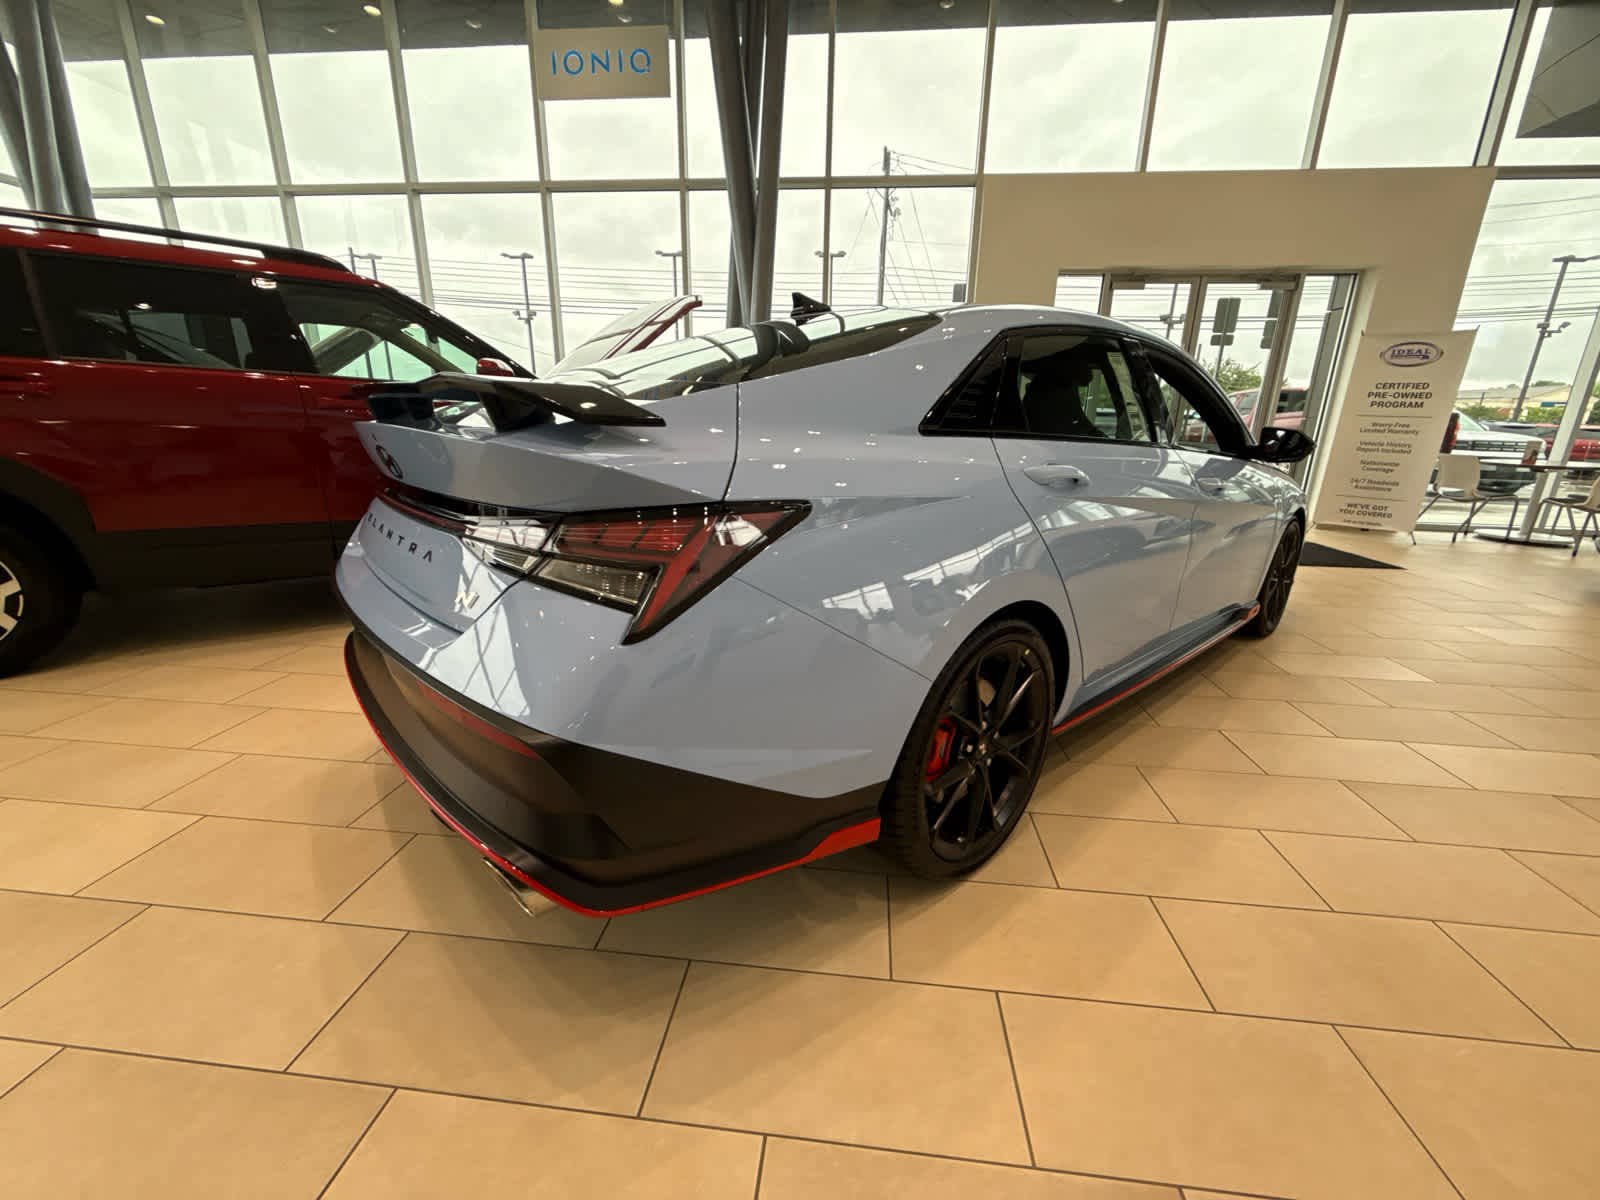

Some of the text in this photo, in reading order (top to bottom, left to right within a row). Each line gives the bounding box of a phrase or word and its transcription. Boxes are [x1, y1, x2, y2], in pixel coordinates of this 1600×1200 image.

[551, 48, 651, 75] IONIQ
[1375, 382, 1430, 390] CERTIFIED
[1367, 391, 1433, 400] PRE-OWNED
[1369, 400, 1424, 409] PROGRAM
[367, 513, 433, 563] ELANTRA
